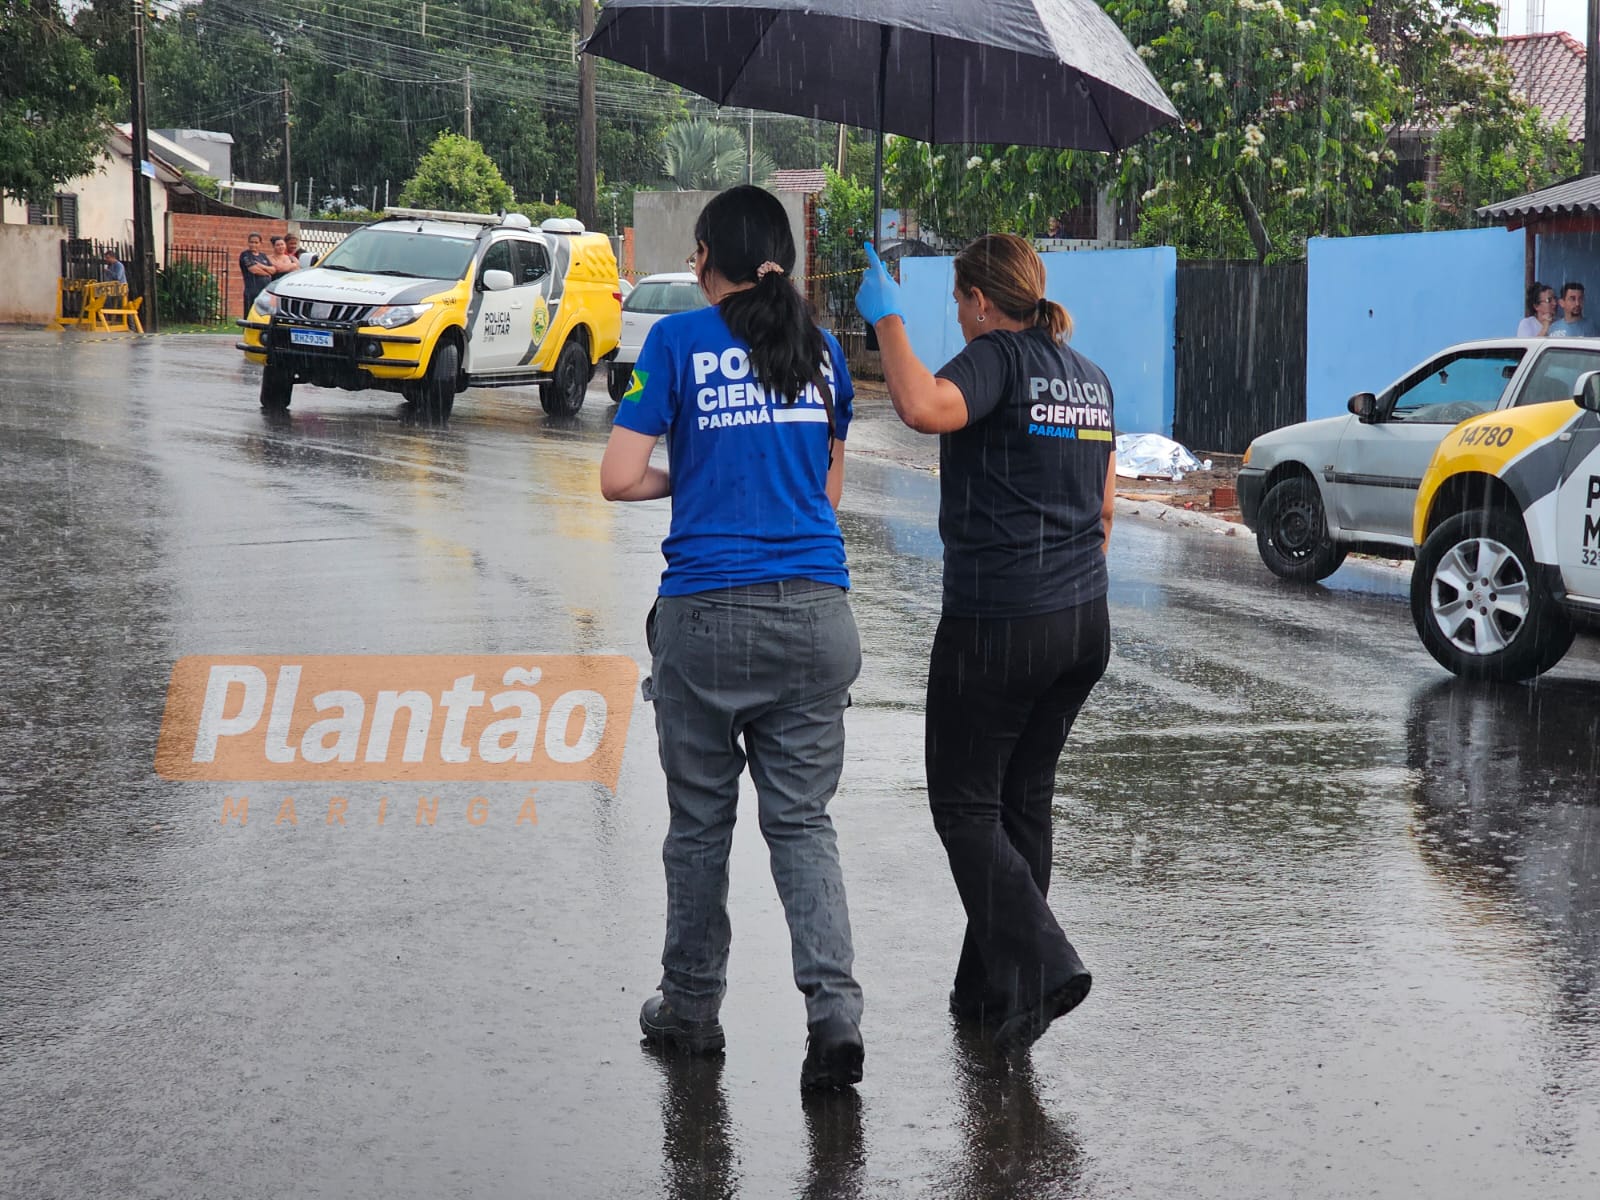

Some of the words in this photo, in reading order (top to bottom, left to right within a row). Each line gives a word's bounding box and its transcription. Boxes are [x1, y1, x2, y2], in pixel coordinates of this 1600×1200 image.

[484, 324, 510, 336] MILITAR
[1029, 377, 1110, 408] POLÍCIA
[698, 406, 771, 430] PARANÁ
[1028, 423, 1076, 439] PARANÁ
[1458, 426, 1514, 447] 14780
